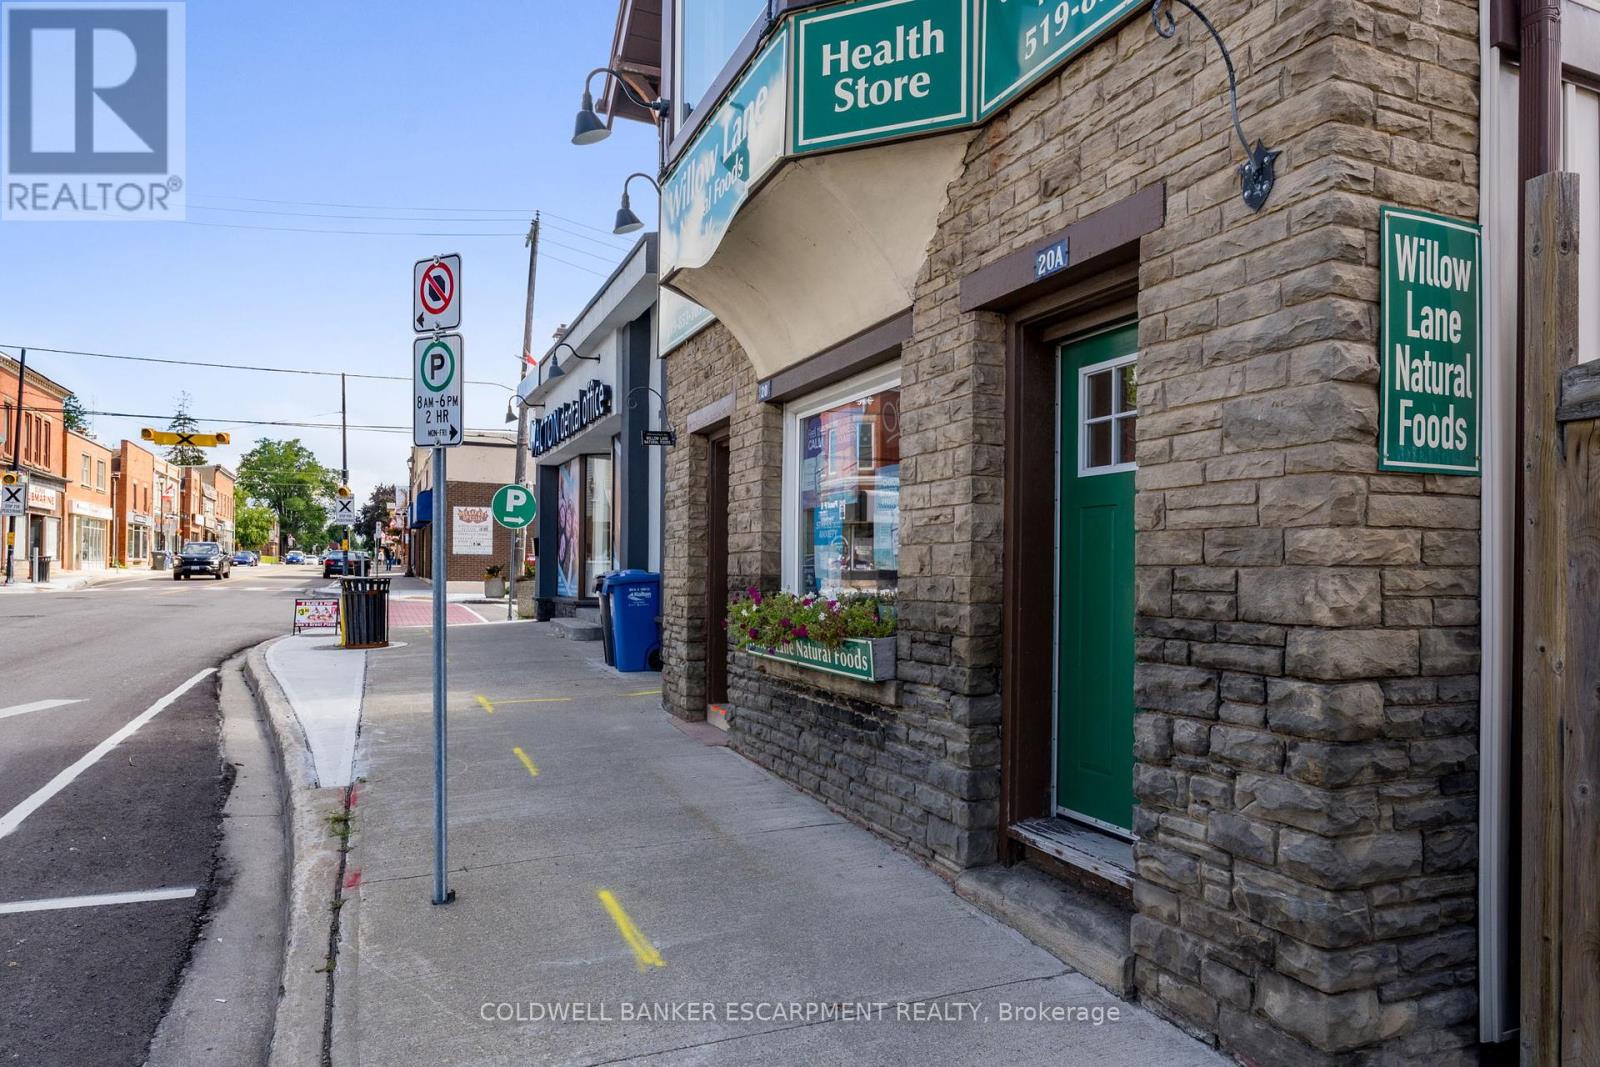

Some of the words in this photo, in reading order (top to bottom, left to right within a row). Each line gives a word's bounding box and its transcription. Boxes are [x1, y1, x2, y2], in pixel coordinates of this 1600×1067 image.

[822, 20, 945, 76] Health
[834, 71, 931, 113] Store
[667, 143, 718, 225] Willow
[723, 85, 768, 162] Lane
[713, 152, 743, 205] Foods
[1038, 245, 1064, 275] 20A
[1394, 233, 1472, 292] Willow
[1406, 290, 1462, 344] Lane
[430, 353, 445, 380] P
[1395, 343, 1473, 399] Natural
[425, 410, 432, 424] 2
[436, 409, 449, 423] HR
[560, 400, 580, 440] dental
[581, 380, 605, 425] office
[1399, 399, 1468, 451] Foods
[506, 489, 527, 512] P
[796, 639, 832, 663] Natural
[834, 648, 868, 672] Foods
